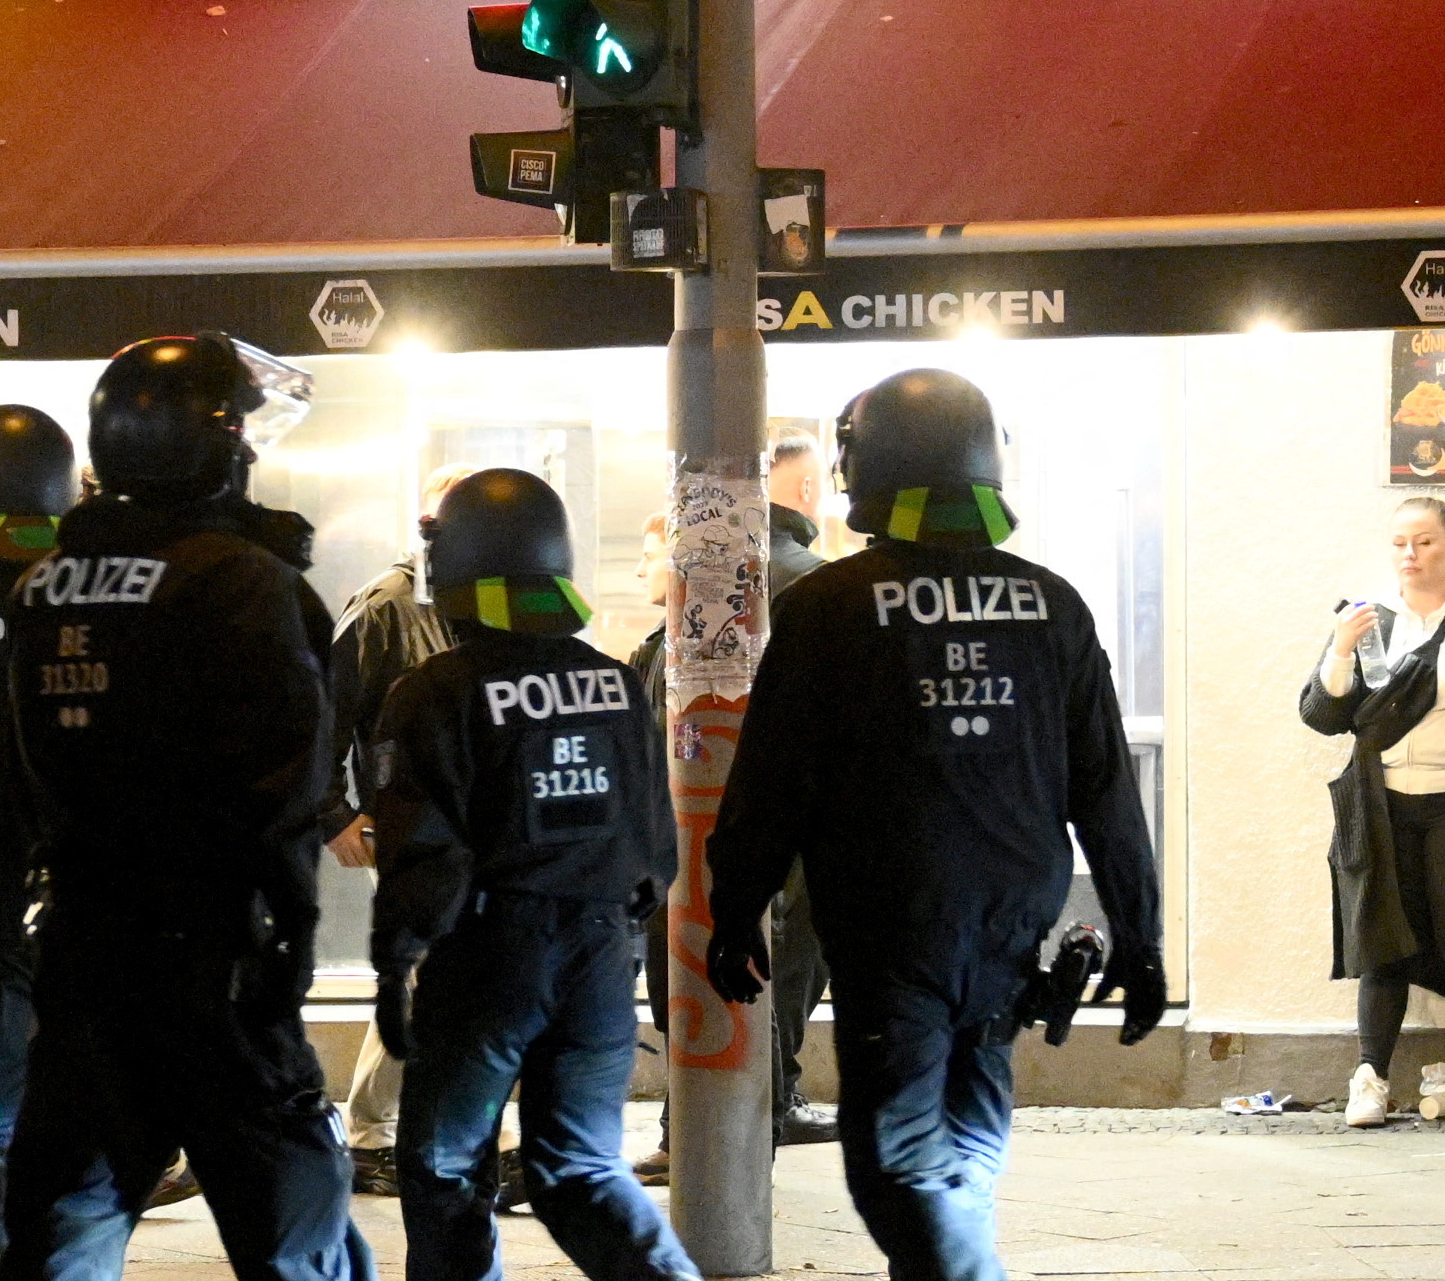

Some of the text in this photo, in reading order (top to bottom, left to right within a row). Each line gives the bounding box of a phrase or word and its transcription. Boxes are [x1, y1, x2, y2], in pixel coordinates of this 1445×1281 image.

[521, 159, 544, 171] CISCO
[521, 171, 543, 182] PEMA
[333, 291, 364, 304] Halal
[841, 290, 1065, 330] CHICKEN
[687, 507, 723, 526] LOCAL
[23, 557, 168, 607] POLIZEI
[872, 576, 1048, 627] POLIZEI
[946, 642, 989, 672] BE
[484, 668, 630, 726] POLIZEI
[919, 676, 1015, 707] 31212
[552, 735, 588, 765] BE
[531, 766, 610, 799] 31216
